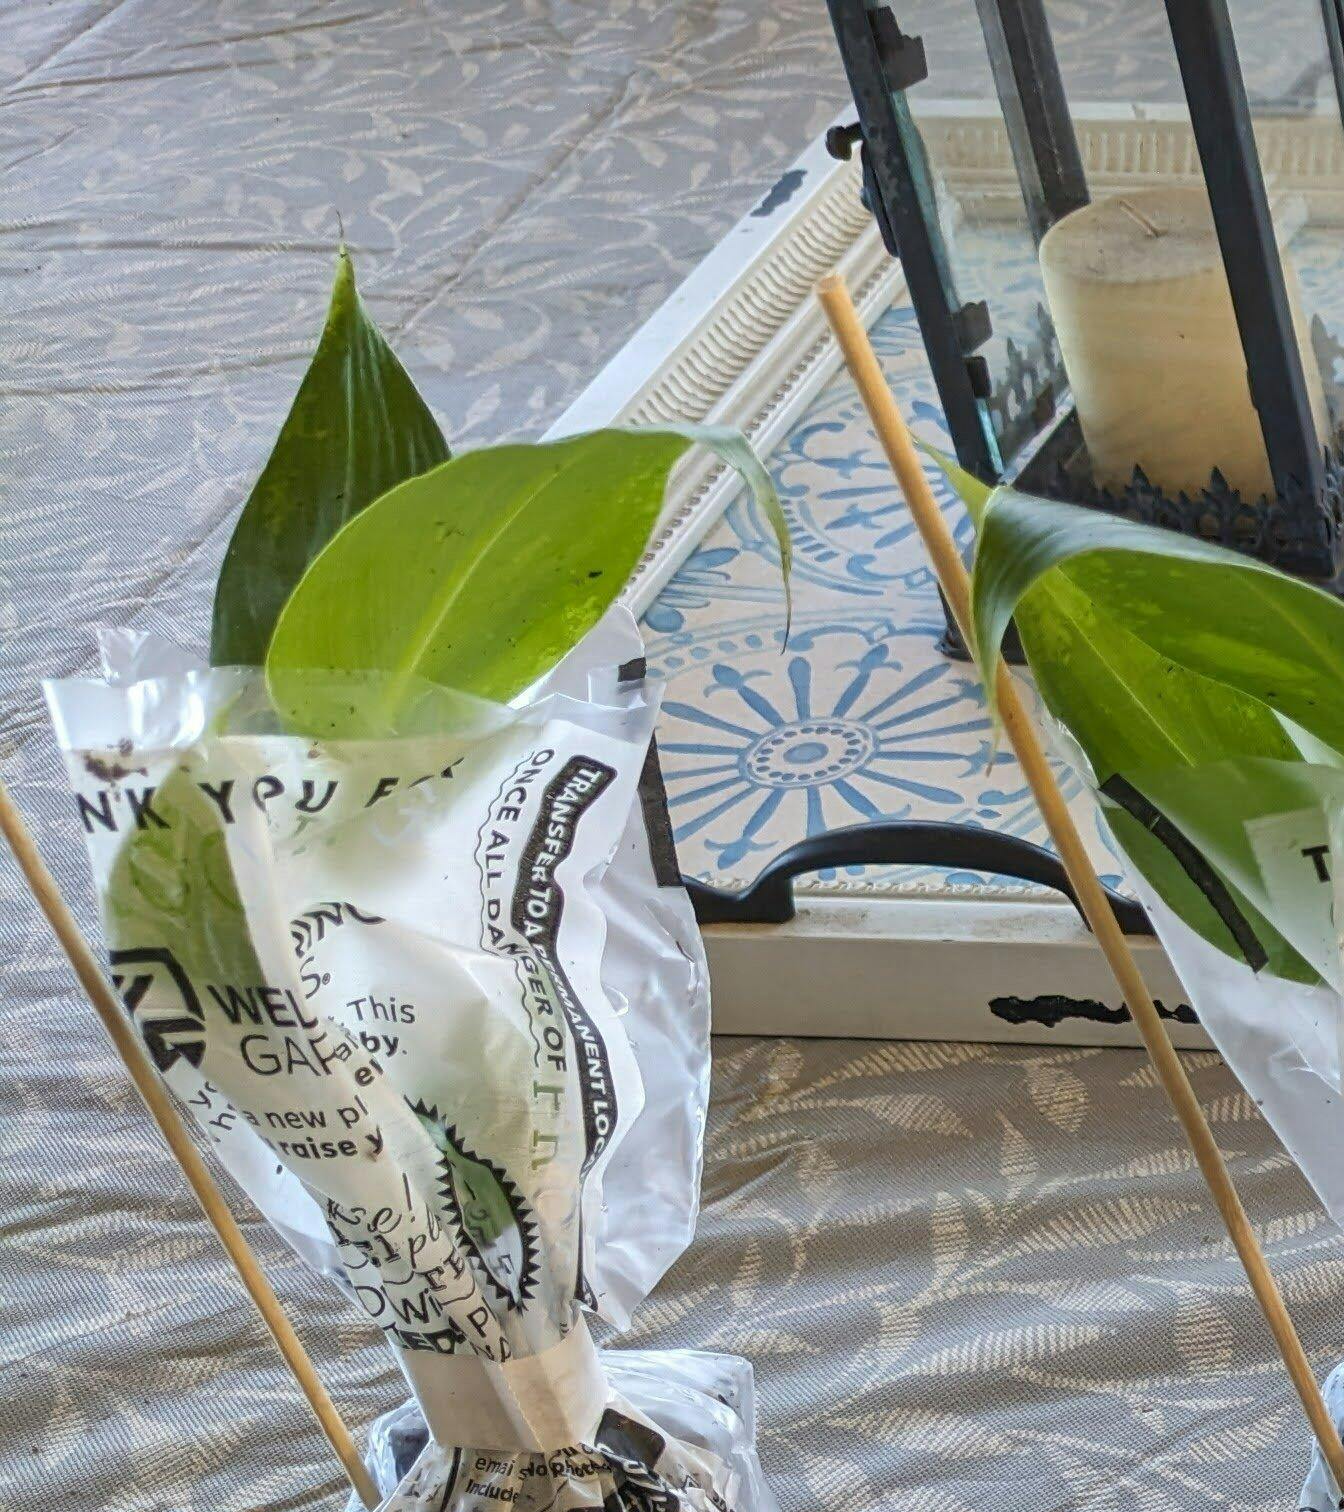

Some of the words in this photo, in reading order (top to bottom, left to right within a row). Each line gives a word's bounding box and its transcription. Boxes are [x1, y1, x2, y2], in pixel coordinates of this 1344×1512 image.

[494, 747, 556, 823] ONCE
[530, 767, 603, 881] TRANSFER
[484, 829, 512, 890] ALL
[525, 887, 551, 919] TO
[523, 918, 543, 939] A
[484, 897, 554, 1018] DANGER
[346, 995, 416, 1024] This
[543, 1025, 567, 1074] OF
[266, 1104, 328, 1130] new
